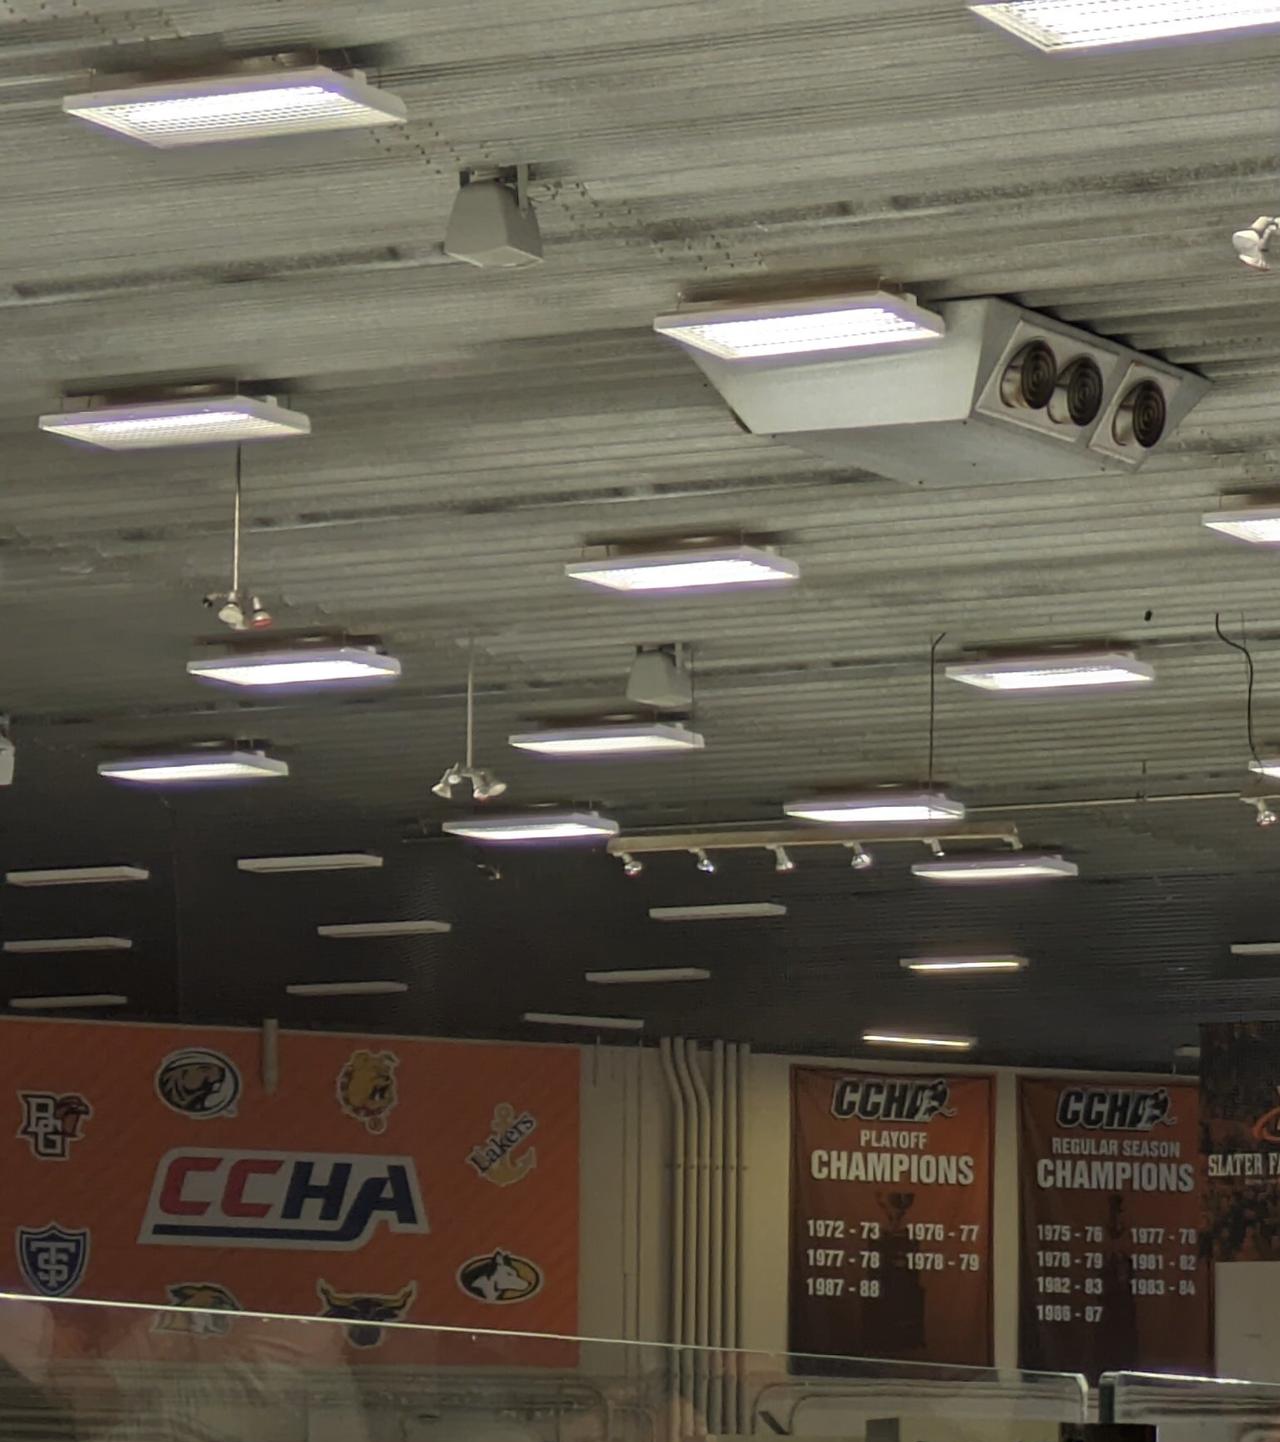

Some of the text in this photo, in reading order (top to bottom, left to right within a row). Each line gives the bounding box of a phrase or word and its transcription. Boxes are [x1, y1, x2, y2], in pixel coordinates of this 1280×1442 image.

[470, 1117, 534, 1173] Lakers
[860, 1129, 928, 1150] PLAYOFF
[1051, 1137, 1180, 1158] REGULAR SEASON
[810, 1149, 974, 1185] CHAMPIONS
[1208, 1152, 1263, 1177] SLATER
[1036, 1158, 1195, 1193] CHAMPIONS
[155, 1156, 419, 1241] CCHA
[807, 1219, 844, 1238] 1972
[860, 1221, 881, 1240] 73
[906, 1223, 944, 1241] 1976
[959, 1224, 980, 1242] 77
[1036, 1224, 1071, 1242] 1975
[1131, 1227, 1164, 1244] 1977
[807, 1249, 844, 1267] 1977
[860, 1250, 880, 1269] 78
[905, 1252, 944, 1270] 1978
[959, 1253, 980, 1272] 79
[806, 1277, 844, 1296] 1987
[859, 1279, 880, 1297] 88
